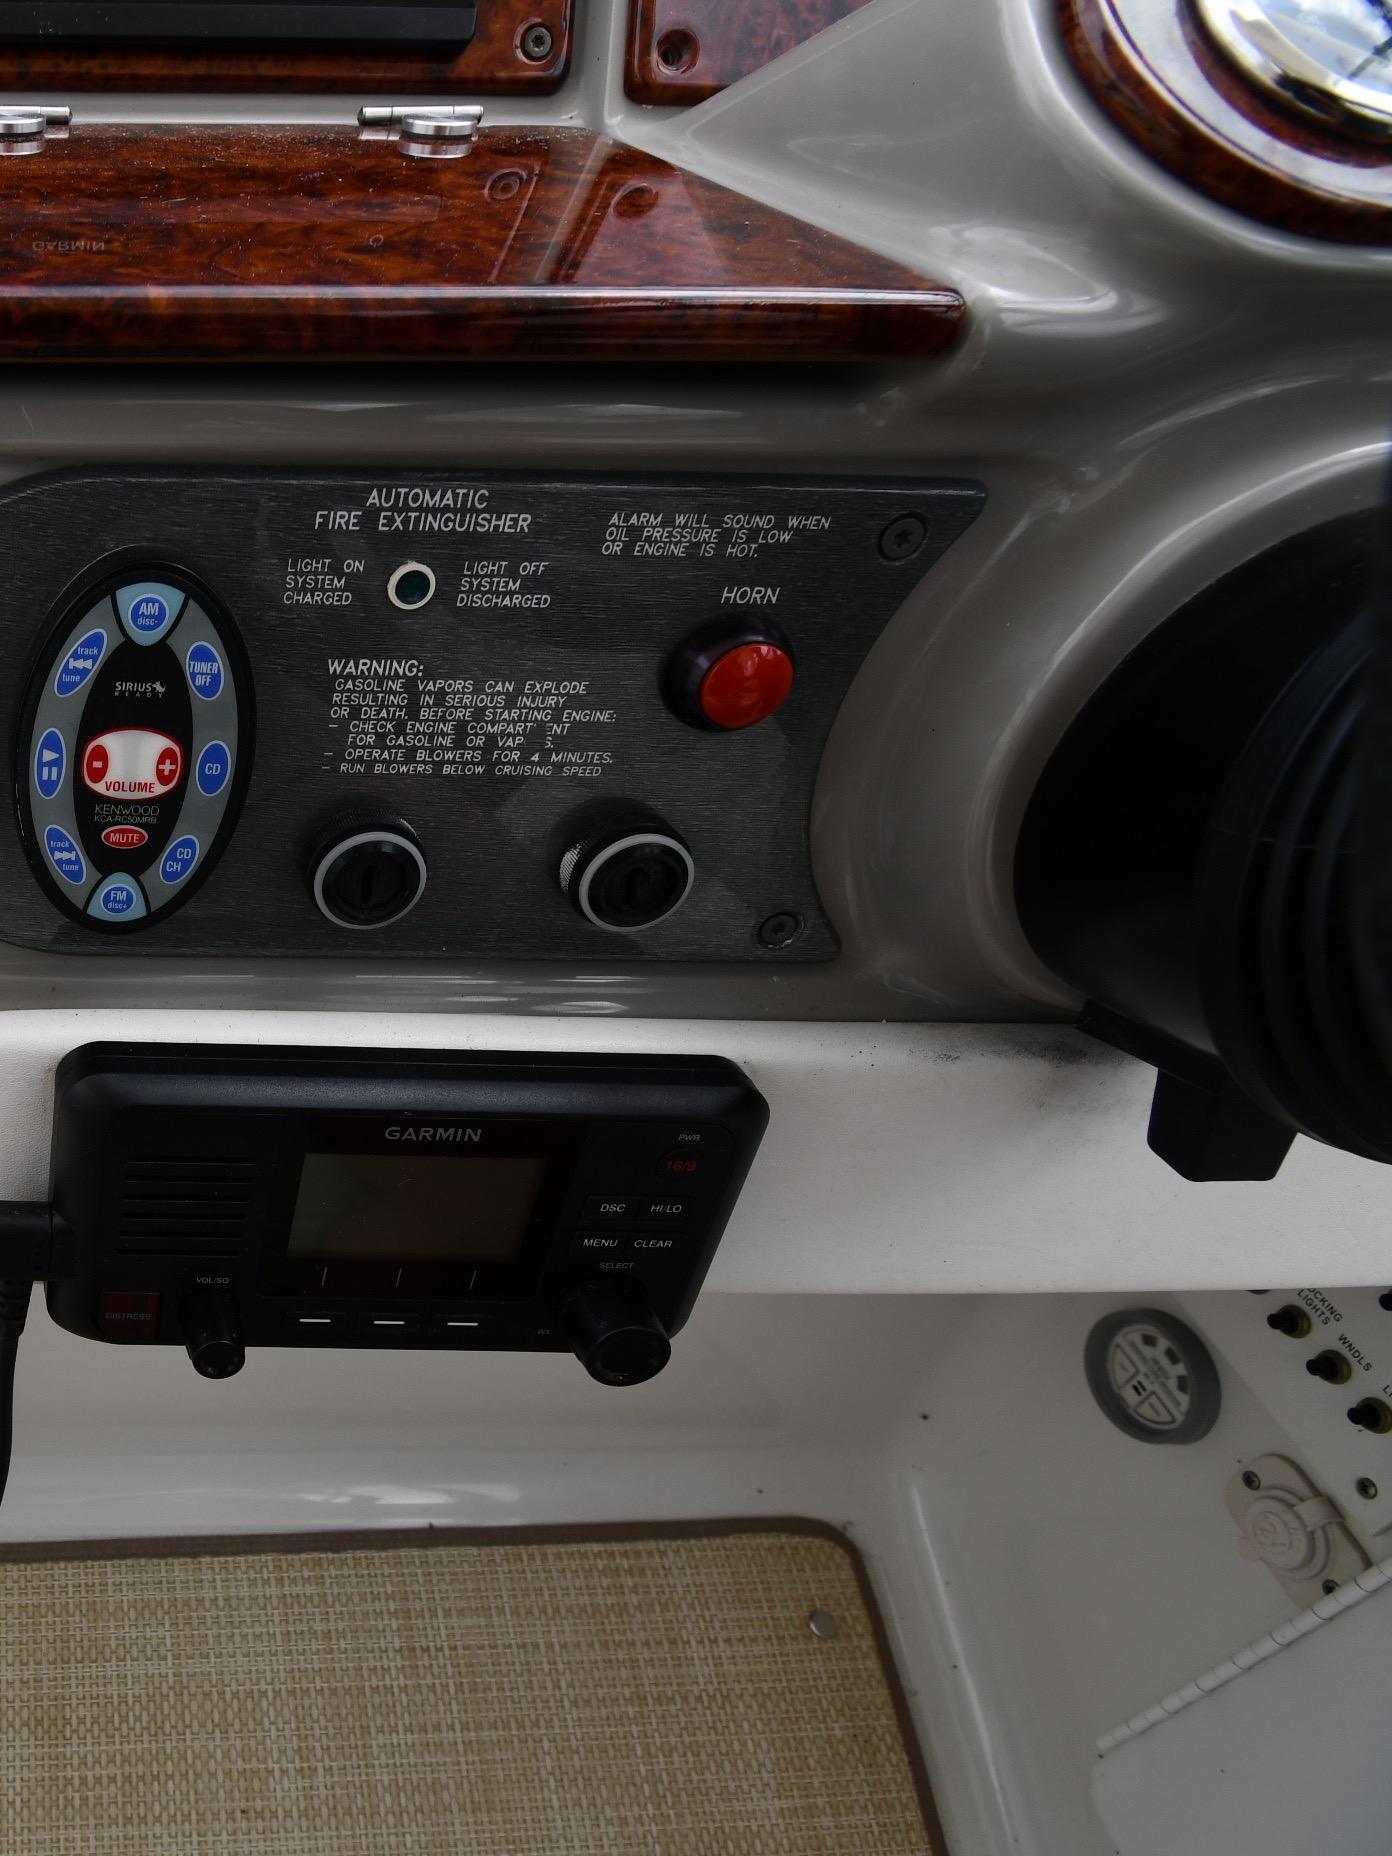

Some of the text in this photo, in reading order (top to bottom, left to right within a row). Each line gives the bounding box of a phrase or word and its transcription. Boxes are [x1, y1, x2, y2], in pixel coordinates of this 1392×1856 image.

[366, 488, 489, 508] AUTOMATIC
[314, 511, 531, 533] FIRE EXTINGUISHER
[608, 513, 831, 529] ALARM WILL SOUND WHEN
[606, 528, 793, 543] OIL PRESSURE IS LOW
[601, 542, 759, 558] OR ENGINE IS HOT.
[287, 559, 365, 573] LIGHT ON
[463, 562, 549, 576] LIGHT OFF
[286, 576, 345, 589] SYSTEM
[460, 578, 521, 591] SYSTEM
[283, 592, 352, 605] CHARGED
[457, 594, 551, 608] DISCHARGED
[721, 587, 780, 604] HORN
[139, 602, 159, 616] AM
[78, 646, 98, 655] track
[189, 661, 218, 674] TUNER
[328, 659, 424, 677] WARNING:
[62, 674, 80, 682] tune
[195, 675, 212, 686] OFF
[115, 682, 152, 692] SIRIUS
[335, 679, 589, 694] GASOLINE VAPORS CAN EXPLODE
[332, 693, 568, 708] RESULTING IN SERIOUS INJURY
[330, 707, 616, 722] OR DEATH. BEFORE STARTING ENGINE:
[350, 721, 395, 733] CHECK
[406, 722, 457, 734] ENGINE
[467, 723, 571, 735] COMPARTENT
[347, 735, 375, 745] FOR
[387, 735, 455, 747] GASOLINE
[466, 736, 484, 747] OR
[345, 749, 405, 761] OPERATE
[416, 750, 481, 761] BLOWERS
[493, 751, 520, 762] FOR
[531, 752, 539, 762] 4
[550, 752, 613, 763] MINUTES.
[205, 763, 221, 775] CD
[340, 763, 364, 774] RUN
[374, 764, 432, 775] BLOWERS
[442, 765, 485, 775] BELOW
[495, 765, 553, 776] CRUISING
[563, 766, 601, 777] SPEED
[105, 781, 155, 793] VOLUME
[94, 804, 160, 816] KENWOOD
[50, 840, 69, 848] track
[109, 832, 140, 843] MUTE
[177, 848, 191, 859] CD
[63, 863, 79, 871] tune
[167, 861, 181, 872] CH
[110, 891, 127, 901] FM
[384, 1126, 482, 1143] GARMIN
[600, 1204, 625, 1213] DSC
[650, 1205, 682, 1213] HI/LO
[583, 1239, 618, 1247] MENU
[634, 1240, 673, 1248] CLEAR
[600, 1262, 634, 1270] SELECT
[1297, 1288, 1330, 1325] LIGHTS
[1338, 1333, 1372, 1372] WNDLS
